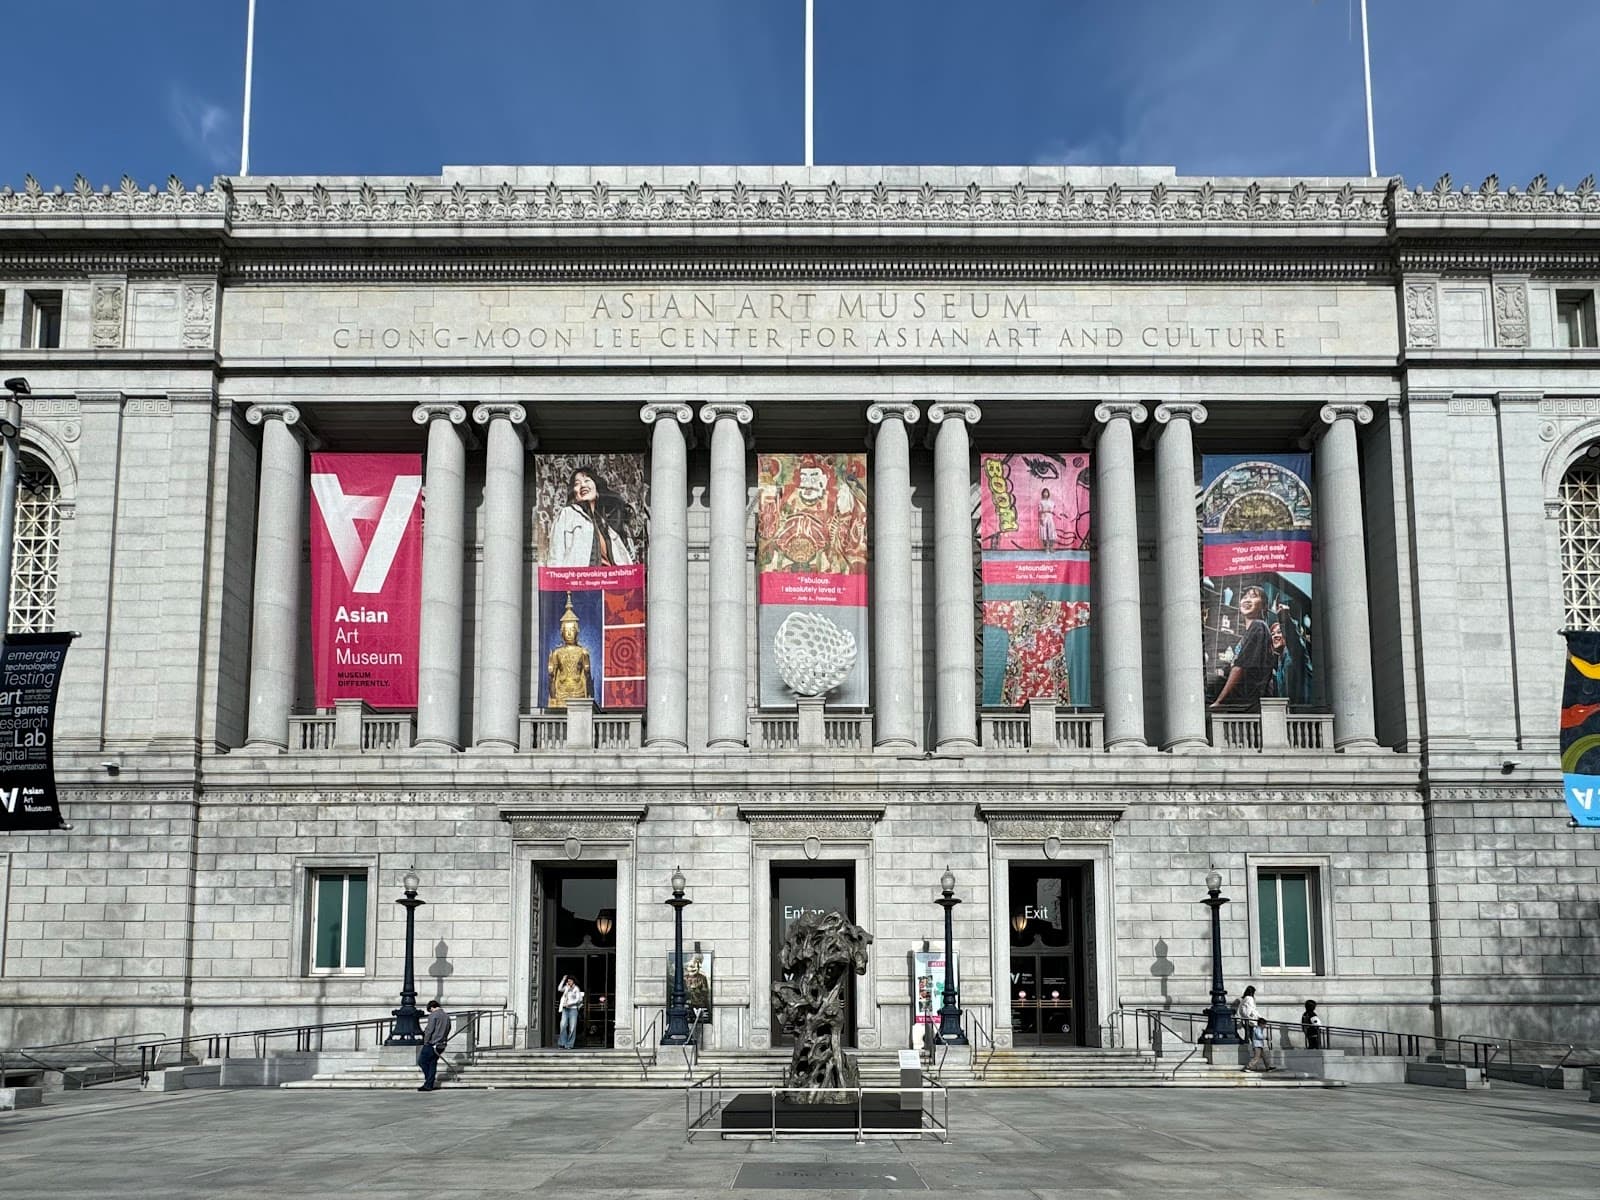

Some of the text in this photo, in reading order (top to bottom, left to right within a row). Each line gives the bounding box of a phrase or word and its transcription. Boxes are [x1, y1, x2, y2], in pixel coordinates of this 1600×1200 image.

[592, 293, 1032, 320] ASIAN ART MUSEUM
[333, 328, 1286, 349] CHONG-MOON LEE CENTER FOR ASIAN ART AND CULTURE
[1270, 544, 1287, 552] easily
[1232, 555, 1253, 563] spend
[334, 606, 388, 623] Asian
[335, 627, 359, 643] Art
[8, 650, 61, 662] emerging
[336, 648, 402, 664] Museum
[5, 663, 57, 671] technologies
[4, 671, 55, 688] Testing
[14, 705, 49, 717] games
[0, 715, 48, 729] esearch
[14, 728, 46, 747] Lab
[22, 787, 44, 795] Asian
[1025, 905, 1048, 919] Exit
